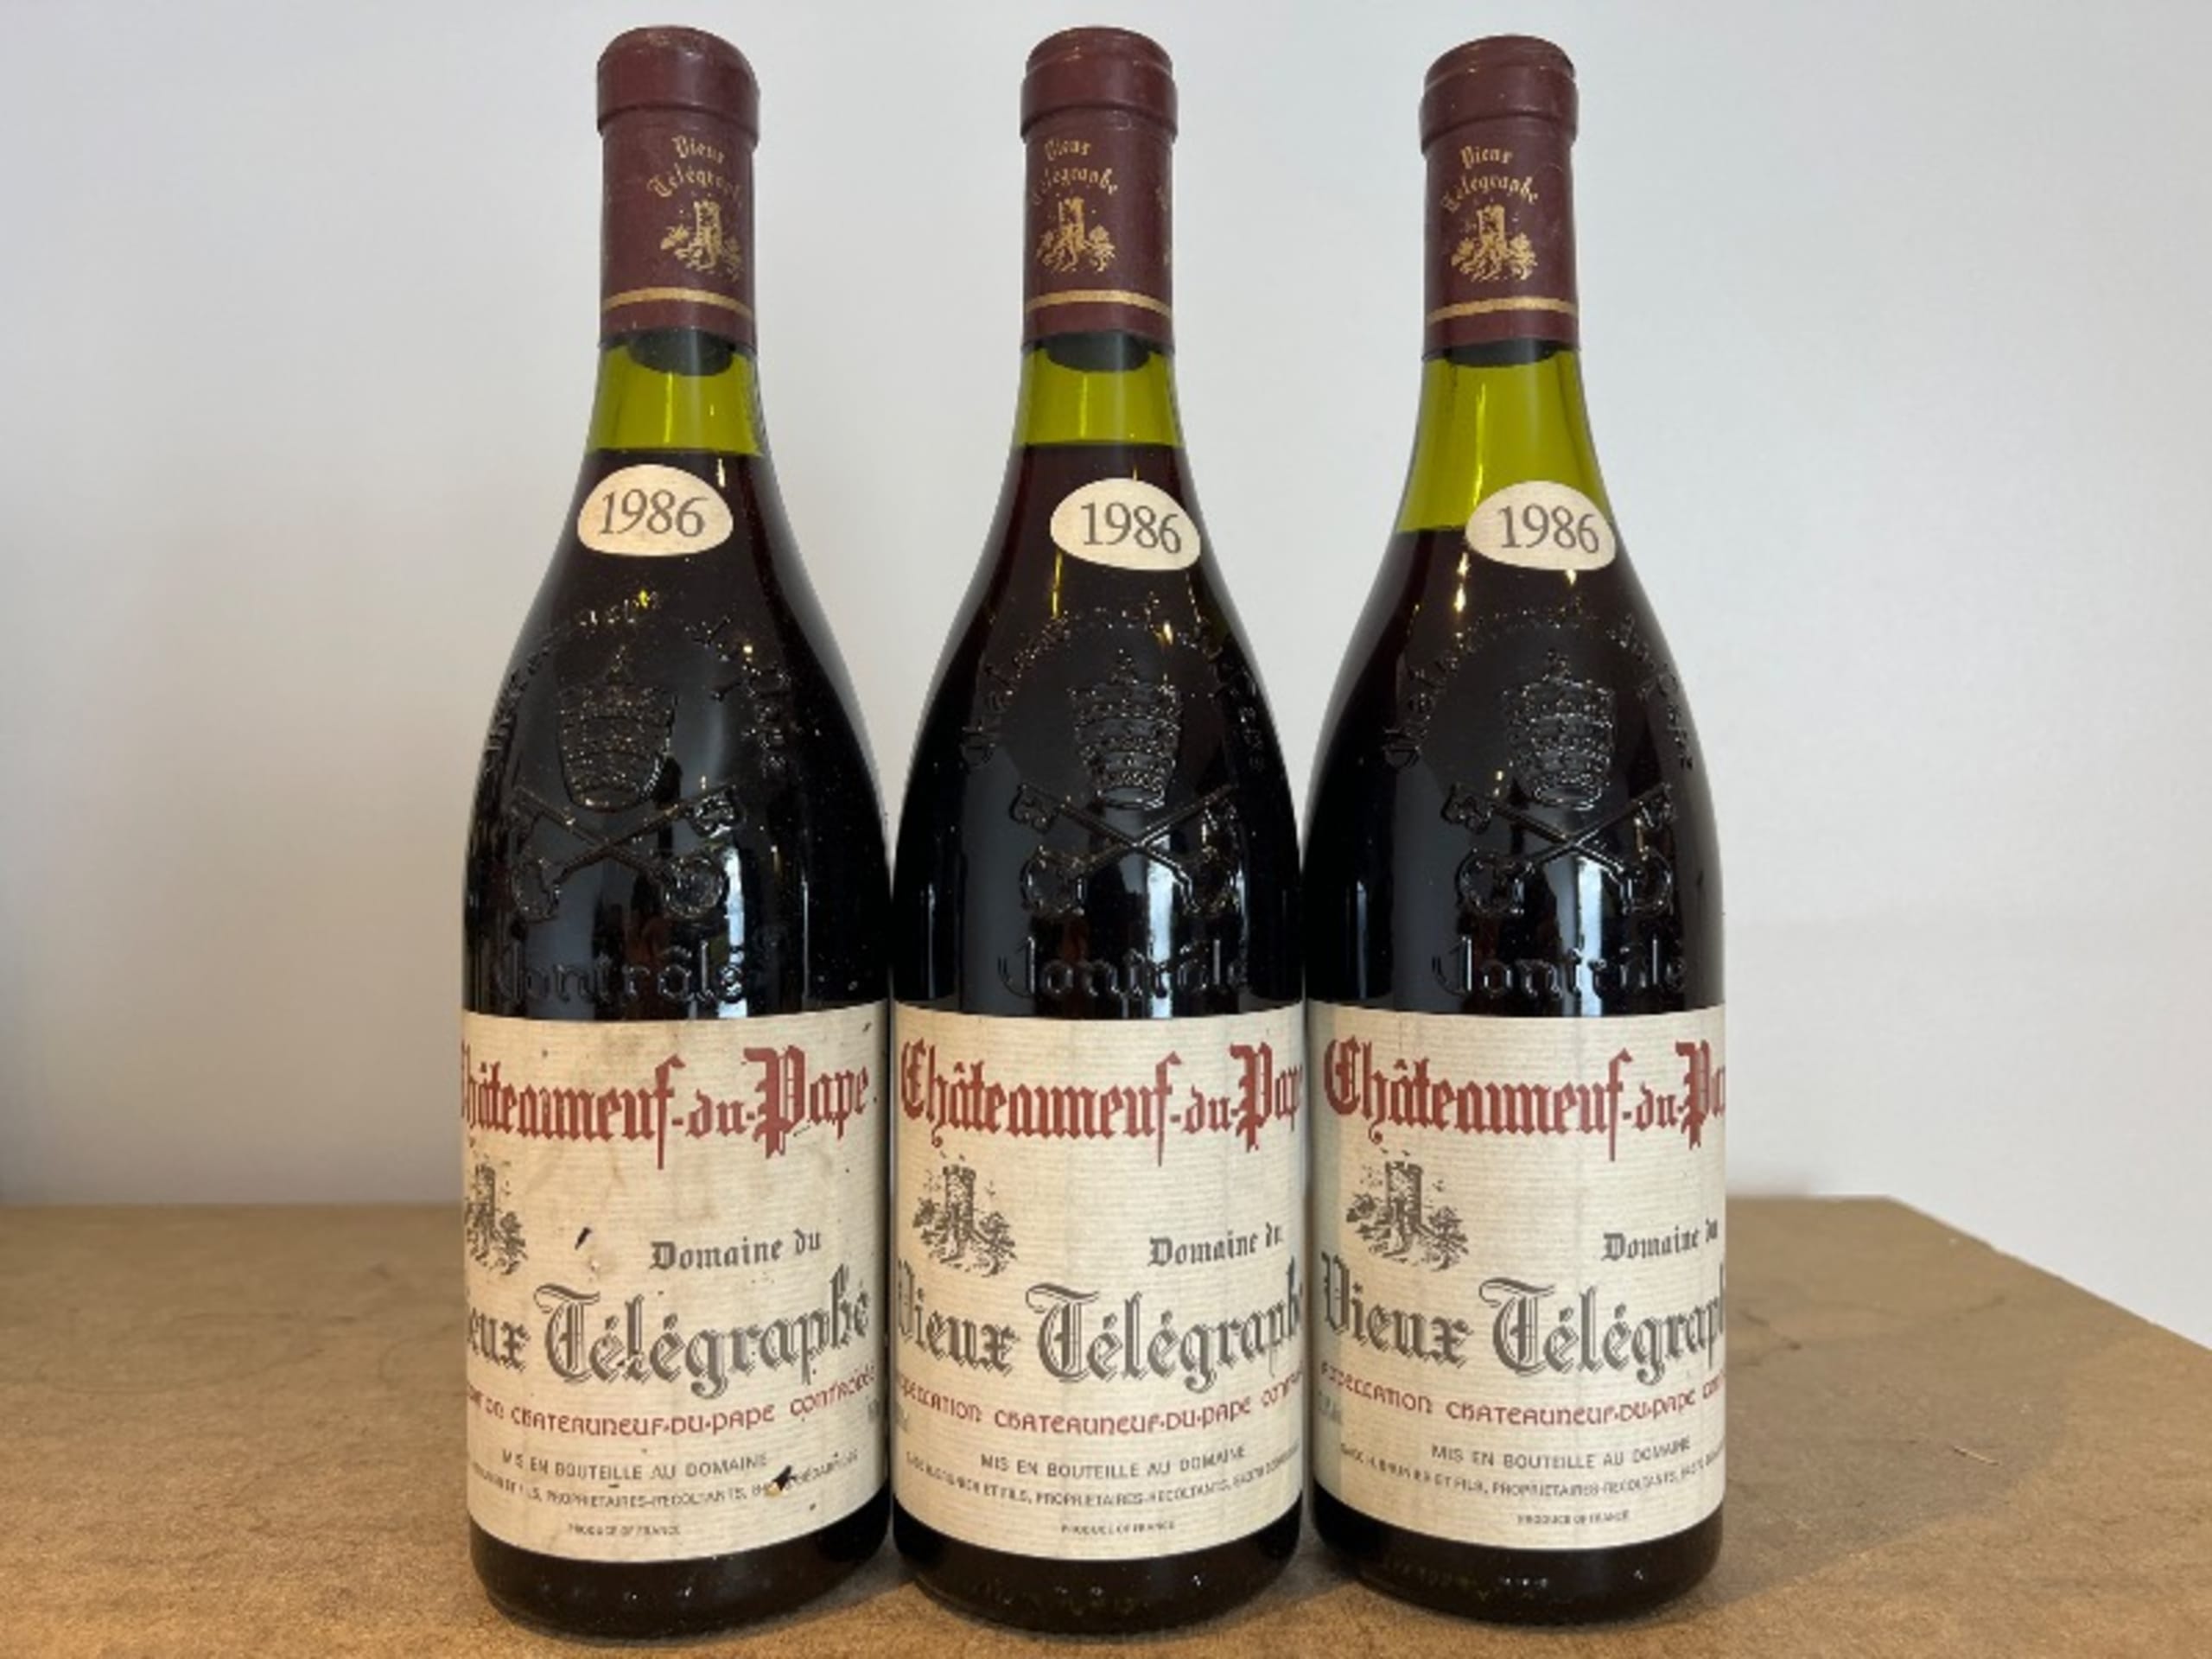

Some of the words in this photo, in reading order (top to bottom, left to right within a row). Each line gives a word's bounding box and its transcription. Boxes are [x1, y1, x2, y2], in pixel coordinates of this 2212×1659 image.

[598, 489, 709, 537] 1986
[1081, 502, 1181, 554] 1986
[1498, 503, 1599, 554] 1986
[899, 1038, 1302, 1166] Châteauneuf-du-Pap
[649, 1238, 783, 1270] Domaine
[793, 1229, 822, 1256] du
[1147, 1230, 1258, 1267] Domaine
[1601, 1226, 1699, 1261] Domaine
[467, 1306, 531, 1372] eux
[533, 1263, 869, 1399] Télégraphe
[897, 1258, 1021, 1375] Vieux
[1321, 1251, 1472, 1369] Vieux
[555, 1462, 642, 1481] BOUTEILLE
[649, 1463, 676, 1480] AU
[685, 1452, 767, 1478] DOMAINE
[981, 1452, 1010, 1472] MIS
[1017, 1459, 1039, 1477] EN
[1046, 1462, 1140, 1480] BOUTEILLE
[1179, 1445, 1246, 1472] DOMAINE
[1431, 1444, 1464, 1463] MIS
[1472, 1451, 1495, 1467] EN
[1503, 1453, 1597, 1470] BOUTEILLE
[1603, 1452, 1624, 1467] AU
